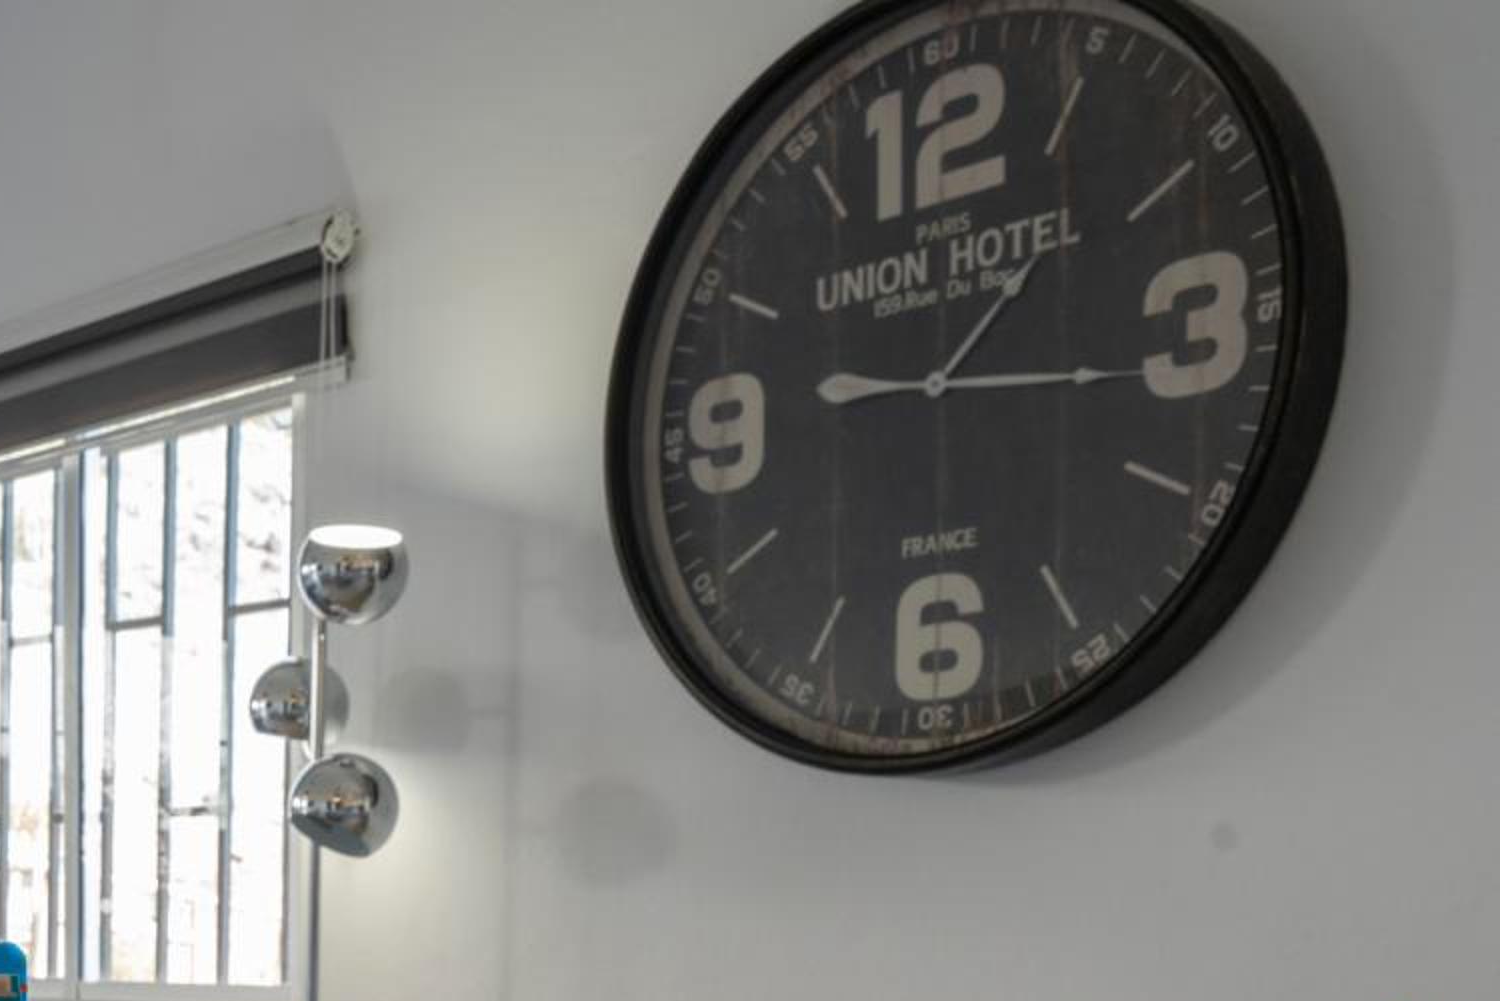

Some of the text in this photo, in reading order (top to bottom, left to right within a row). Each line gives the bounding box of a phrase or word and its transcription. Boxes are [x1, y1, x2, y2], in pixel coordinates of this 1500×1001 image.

[924, 40, 960, 65] 60
[1085, 26, 1110, 54] 5
[786, 128, 819, 161] 55
[864, 61, 1007, 223] 12
[1207, 114, 1240, 153] 10
[916, 212, 972, 244] PARIS
[816, 207, 1082, 311] UNION HOTEL
[1258, 284, 1284, 323] 15
[1142, 251, 1249, 399] 3
[664, 430, 683, 464] 45
[688, 373, 766, 494] 9
[1200, 480, 1235, 529] 20
[902, 526, 979, 558] FRANCE
[691, 574, 718, 606] 40
[894, 572, 985, 700] 6
[1072, 633, 1113, 674] 25
[780, 672, 814, 701] 35
[917, 704, 954, 730] 30
